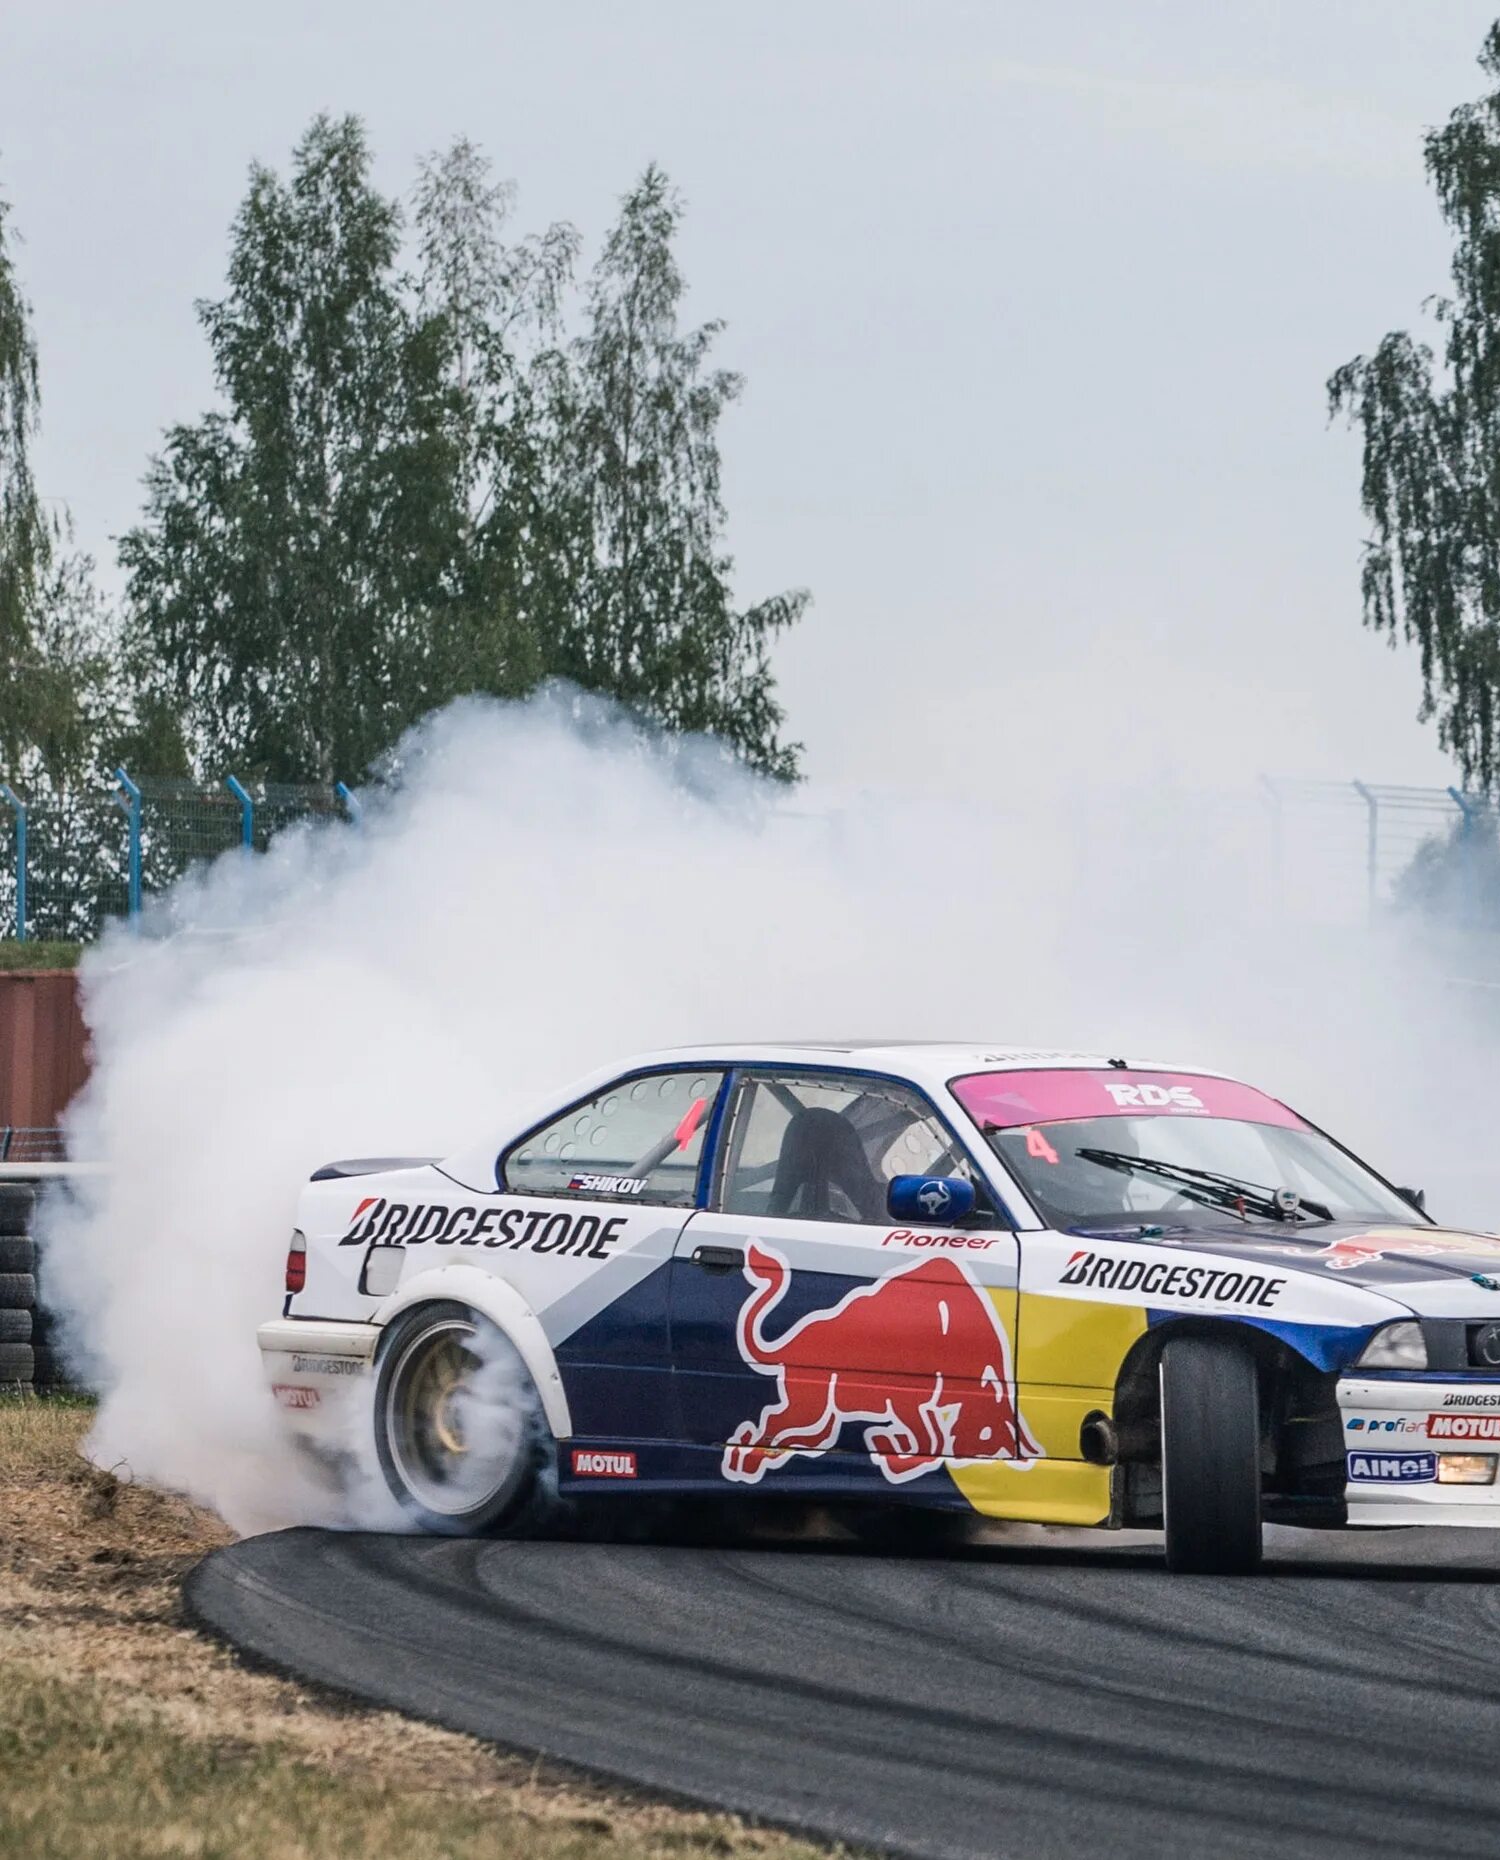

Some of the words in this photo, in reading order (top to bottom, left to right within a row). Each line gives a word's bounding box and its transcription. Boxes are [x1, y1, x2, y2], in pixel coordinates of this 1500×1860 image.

[1104, 1083, 1204, 1108] RDS
[1025, 1130, 1059, 1165] 4
[578, 1173, 649, 1195] SHIKOV
[338, 1198, 629, 1260] BRIDGESTONE
[882, 1230, 999, 1250] Pioneer
[1058, 1250, 1288, 1308] BRIDGESTONE
[1367, 1417, 1429, 1434] profiar
[576, 1454, 634, 1474] MOTUL
[1352, 1458, 1434, 1477] AIMOL
